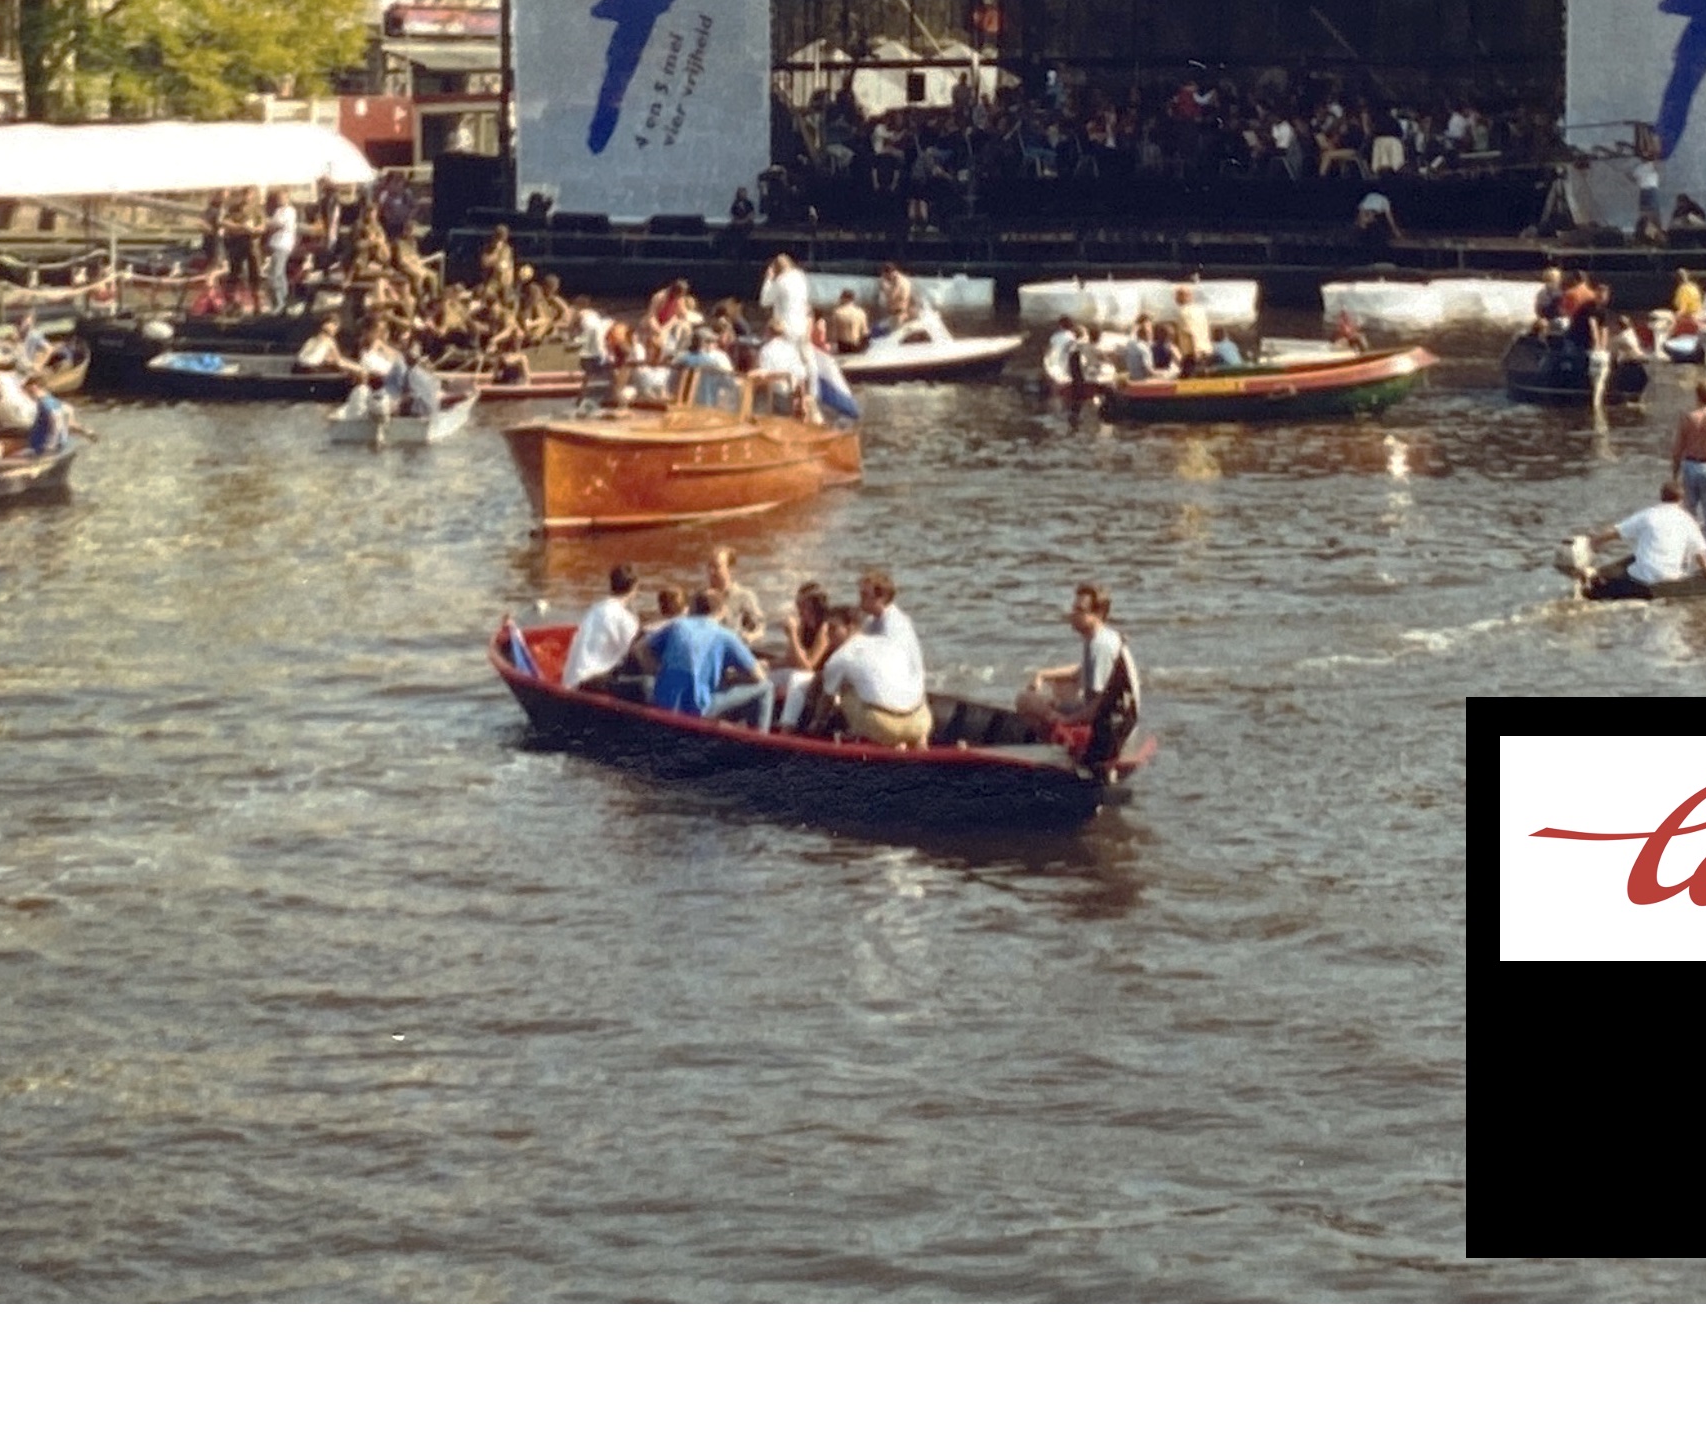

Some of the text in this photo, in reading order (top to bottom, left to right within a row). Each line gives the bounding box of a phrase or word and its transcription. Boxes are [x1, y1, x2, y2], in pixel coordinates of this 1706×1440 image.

[663, 13, 713, 146] vier vrijheid
[664, 31, 684, 76] mei
